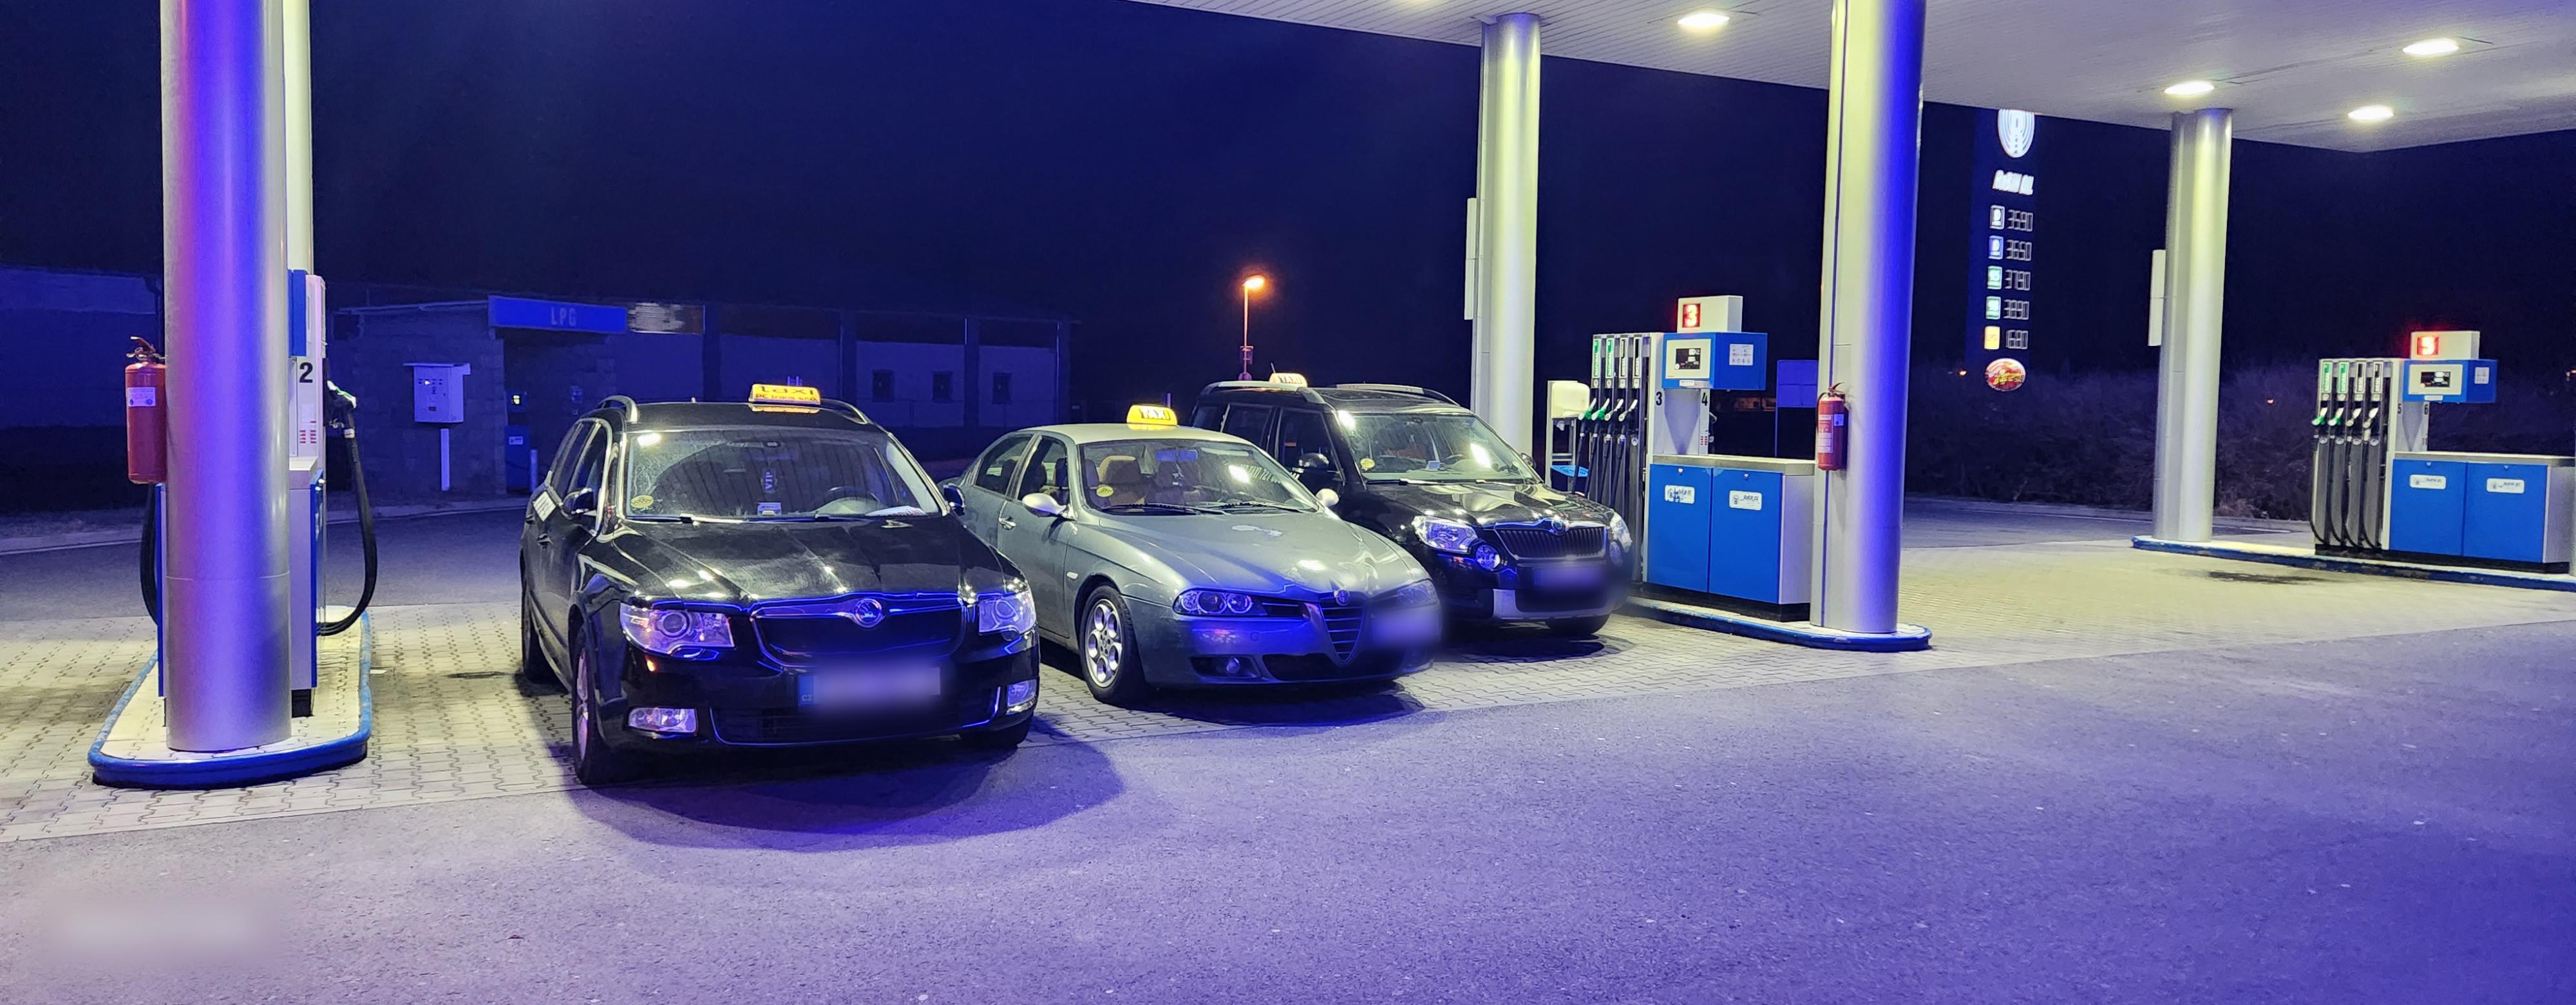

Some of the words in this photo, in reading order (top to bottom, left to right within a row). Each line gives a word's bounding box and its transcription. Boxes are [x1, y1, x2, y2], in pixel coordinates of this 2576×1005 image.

[551, 307, 577, 325] LPG
[1684, 304, 1698, 327] 3
[299, 362, 313, 383] 2
[1277, 376, 1302, 385] TAXI
[1656, 391, 1662, 406] 3
[1701, 392, 1708, 406] 4
[1139, 407, 1171, 421] TAXI
[2398, 403, 2401, 414] 5
[2424, 405, 2429, 415] 6
